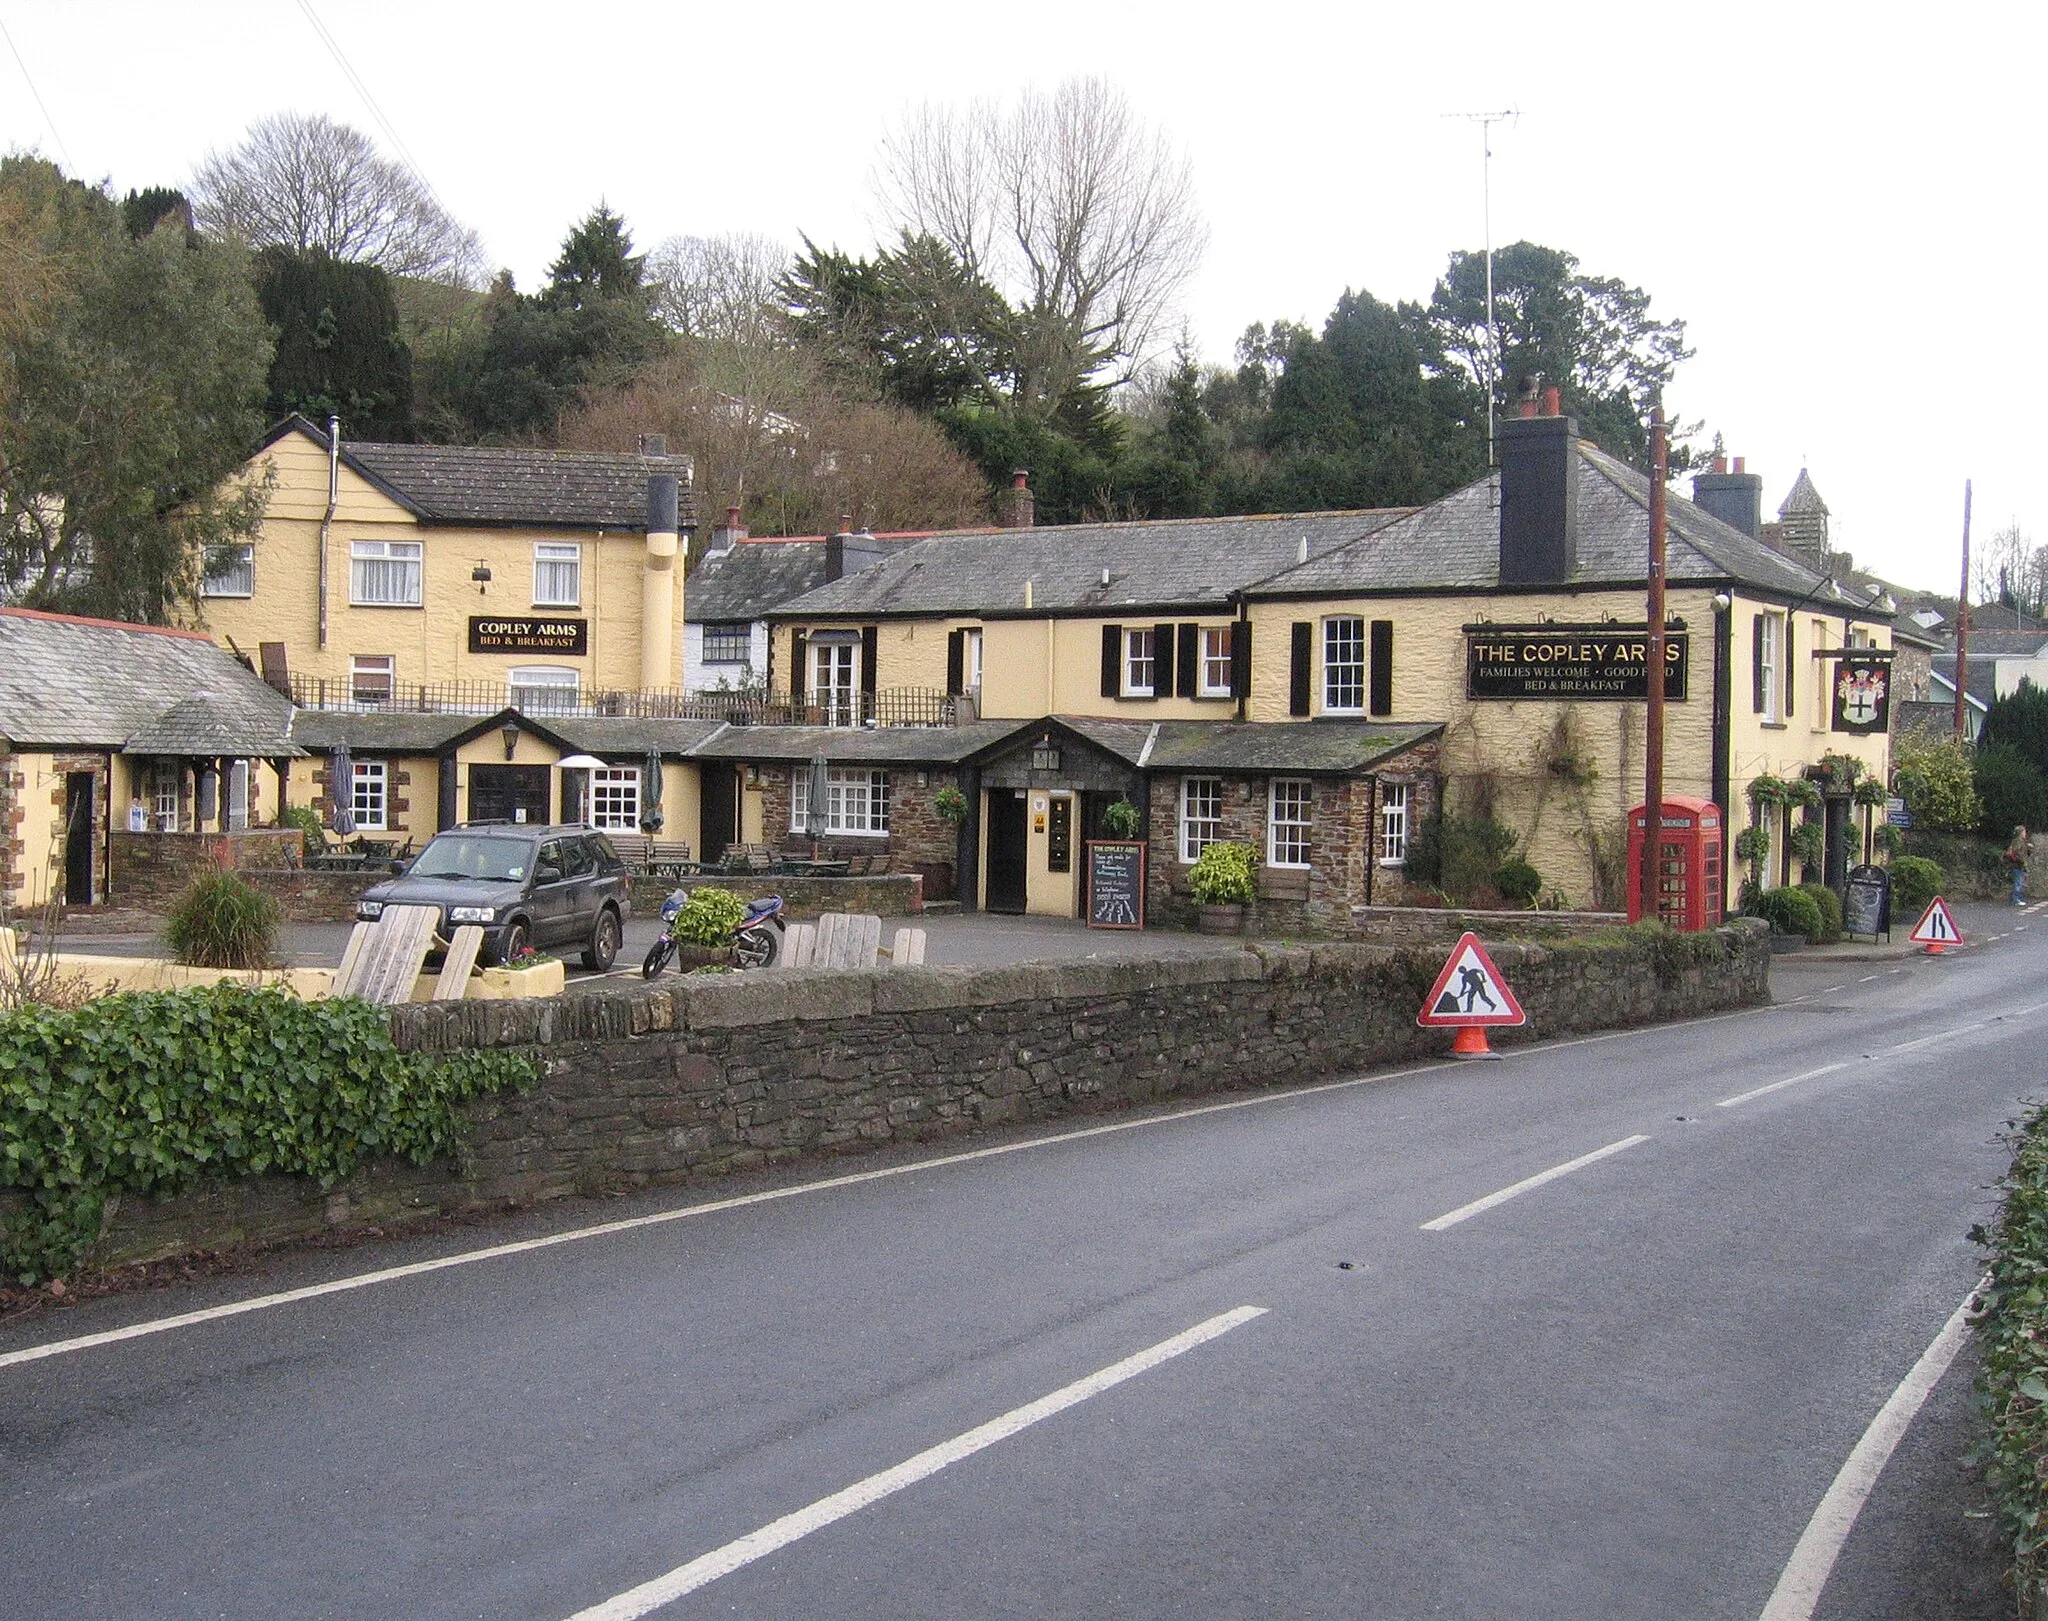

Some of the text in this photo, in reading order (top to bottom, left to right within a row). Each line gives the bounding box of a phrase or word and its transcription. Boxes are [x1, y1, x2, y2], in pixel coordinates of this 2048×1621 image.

[478, 622, 577, 636] COPLEY ARMS
[480, 636, 575, 647] BED & BREAKFAST
[1474, 643, 1680, 662] THE COPLEY ARS
[1479, 667, 1674, 677] FAMILIES WELCOME GOOD FD
[1524, 680, 1626, 691] BED & BREAKFAST
